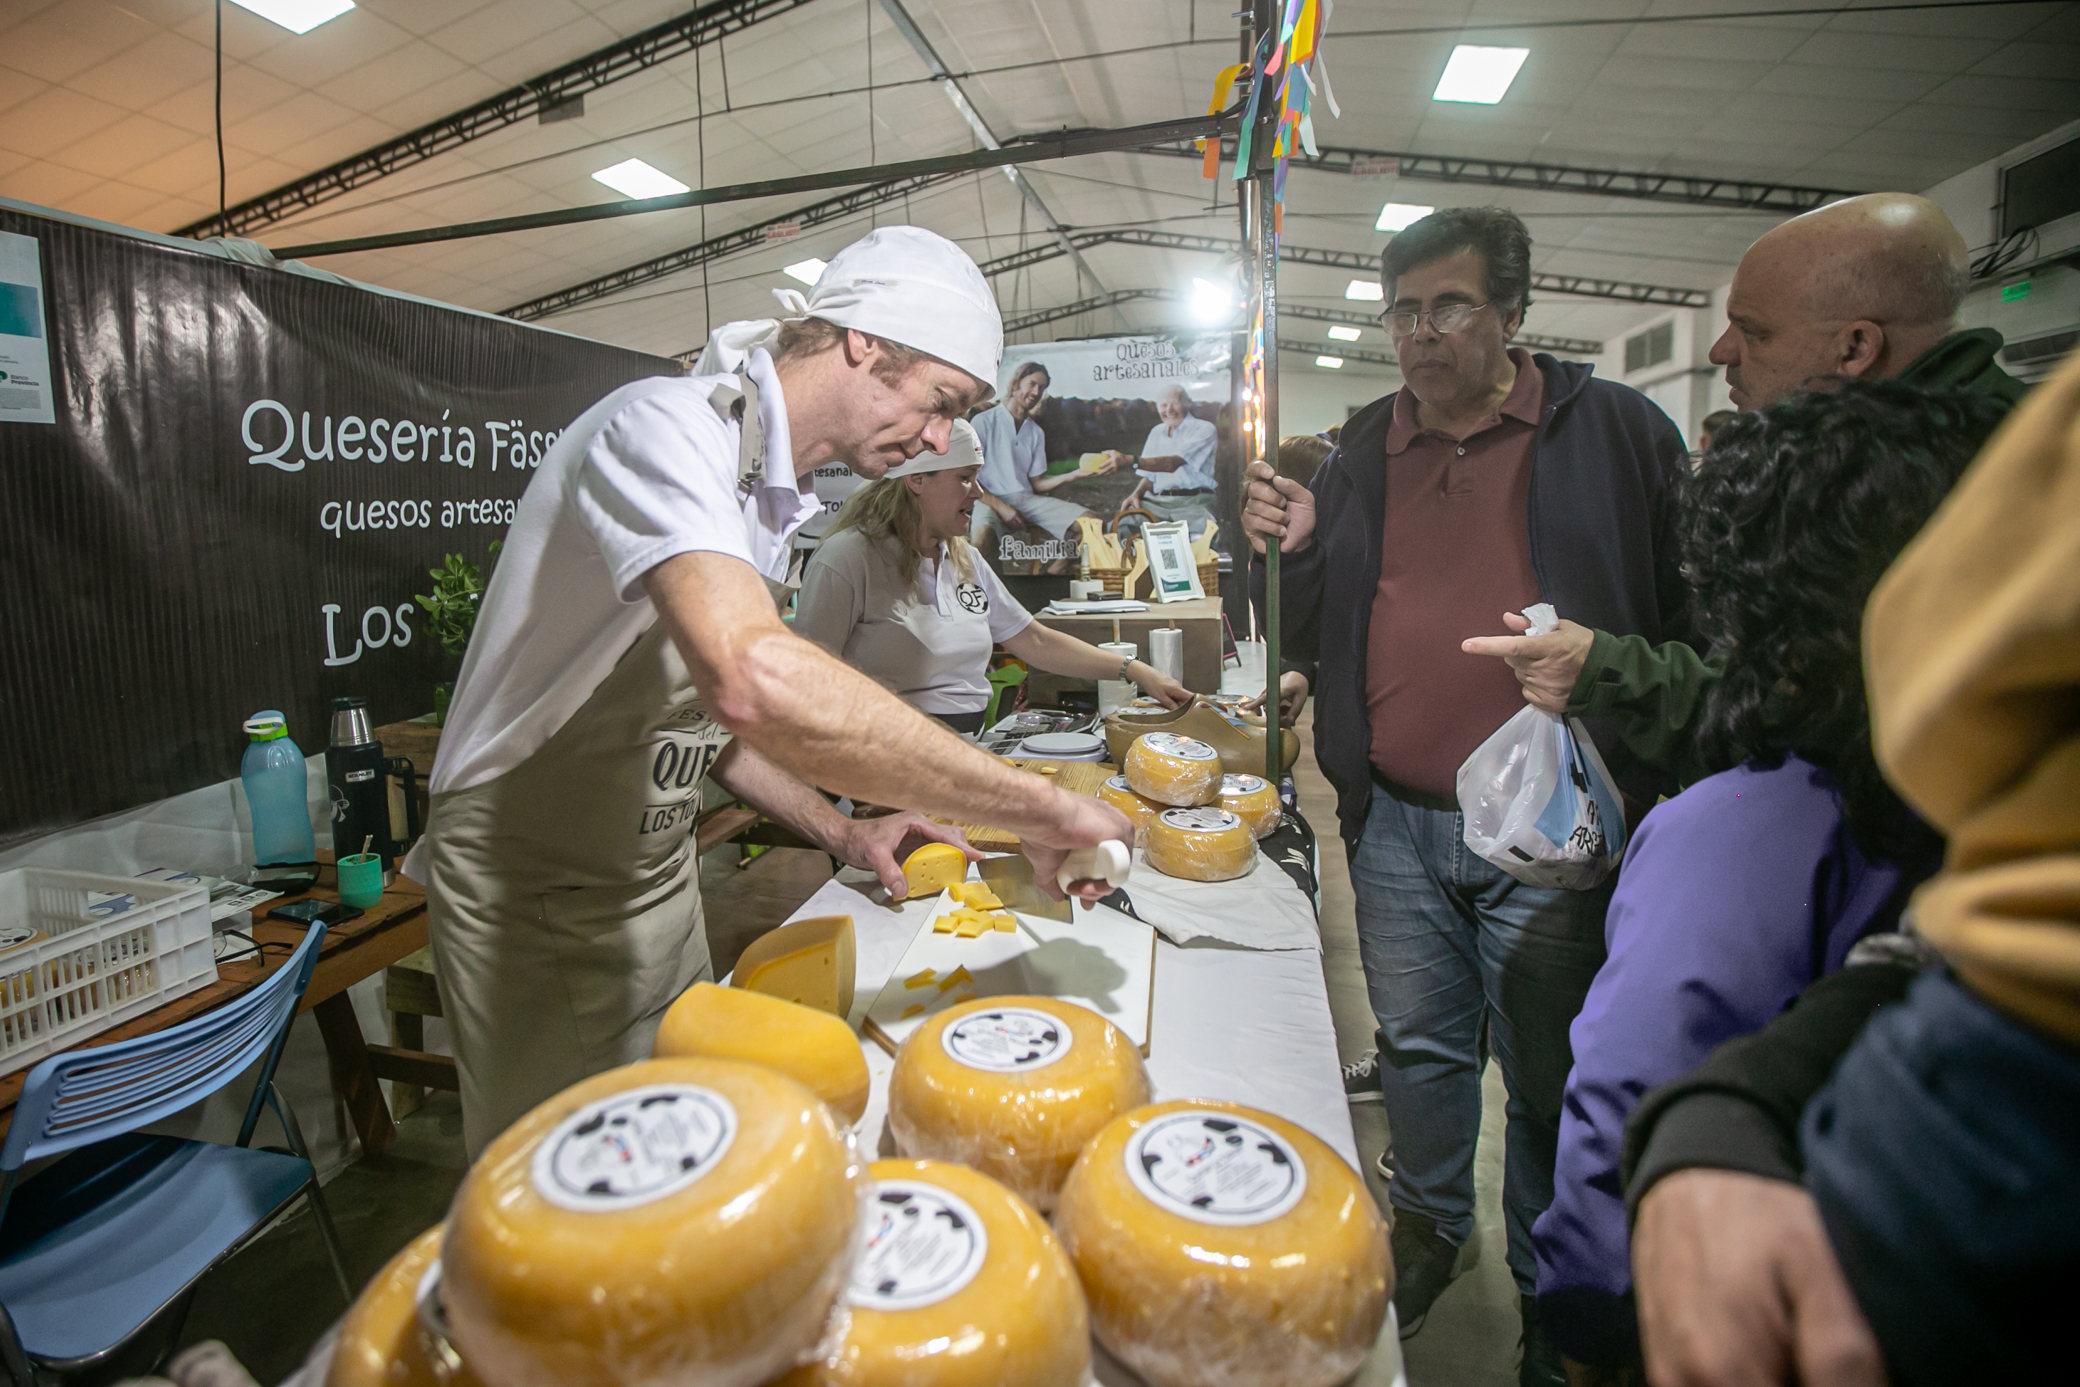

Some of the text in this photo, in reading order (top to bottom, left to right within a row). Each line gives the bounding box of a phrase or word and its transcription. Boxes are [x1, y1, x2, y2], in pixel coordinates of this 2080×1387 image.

[1116, 341, 1176, 363] Quesos
[1093, 360, 1199, 381] artesanales
[241, 399, 563, 472] Quesería Fäs
[320, 498, 521, 538] quesos artesa
[667, 708, 712, 722] FES
[639, 807, 677, 835] LOS
